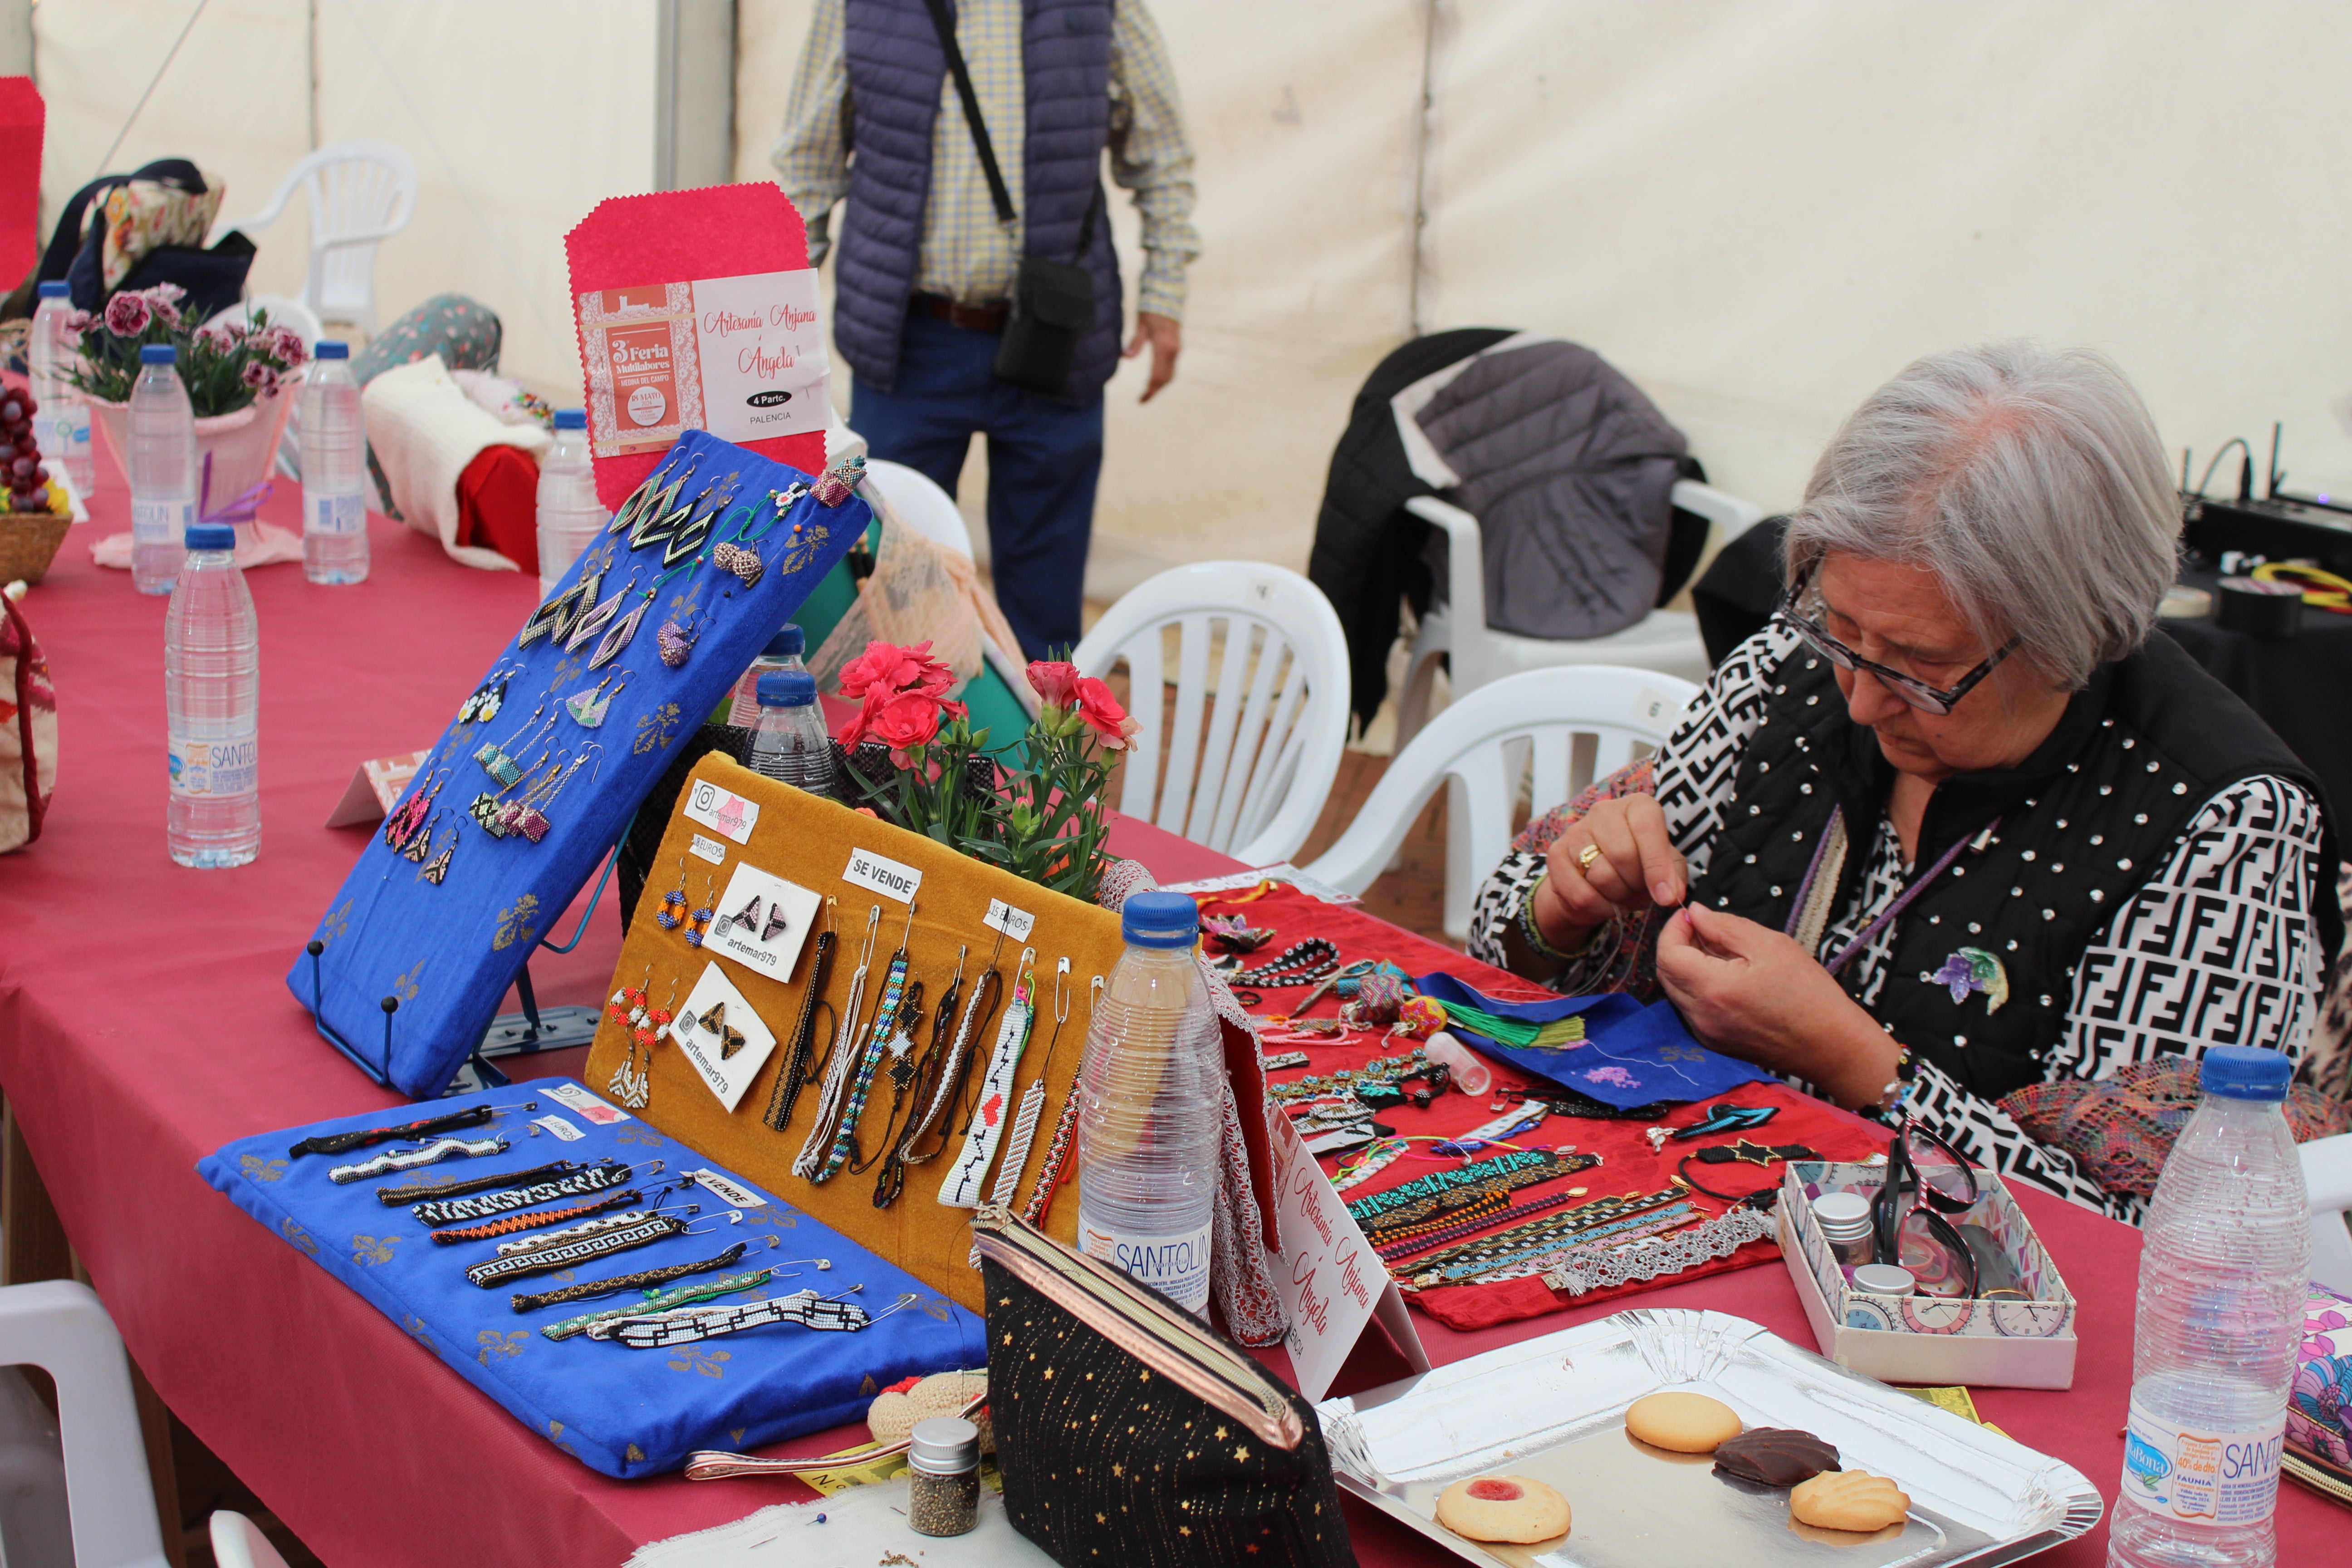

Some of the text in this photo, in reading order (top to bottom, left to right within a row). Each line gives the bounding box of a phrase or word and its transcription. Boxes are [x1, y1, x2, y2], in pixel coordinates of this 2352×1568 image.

[704, 304, 817, 338] Artesanía Anjana
[630, 343, 669, 361] Feria
[738, 334, 794, 380] Ángela
[616, 361, 670, 374] Multilabores
[621, 377, 640, 387] MEDINA
[651, 374, 669, 383] CAMPO
[640, 392, 661, 401] MAYO
[762, 394, 785, 404] Partc.
[750, 412, 791, 425] PALENCIA
[709, 808, 747, 830] artemar979
[853, 859, 913, 895] SE VENDE
[990, 905, 1028, 931] 15 EROS
[727, 937, 777, 967] artemar979
[686, 1039, 729, 1095] artemar979
[707, 1178, 749, 1203] VENDE
[1117, 1230, 1210, 1277] SANTOLÍN
[2178, 1457, 2192, 1470] 40%
[2193, 1460, 2202, 1472] de
[2177, 1475, 2212, 1486] FAUNIA
